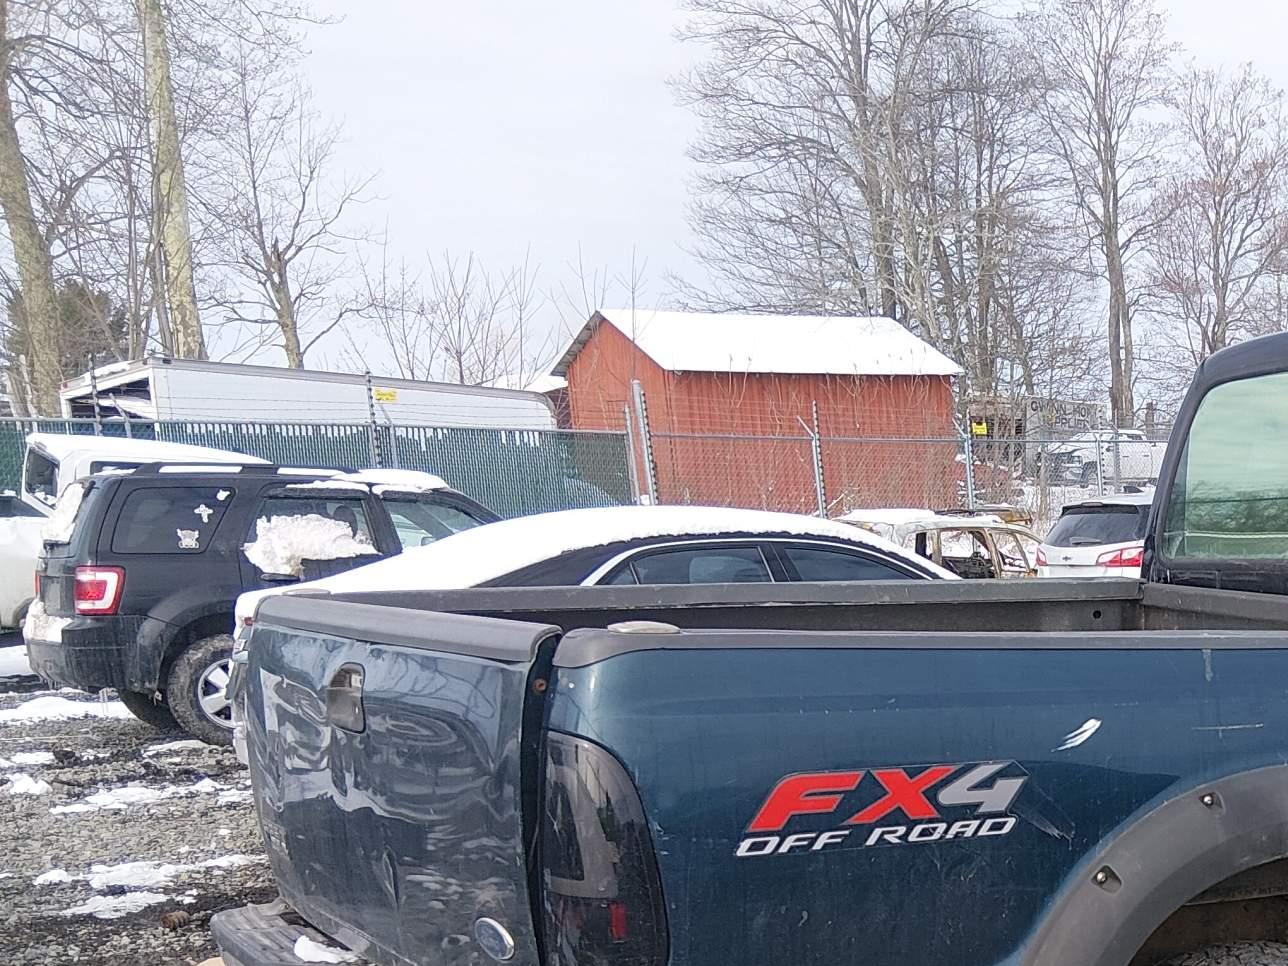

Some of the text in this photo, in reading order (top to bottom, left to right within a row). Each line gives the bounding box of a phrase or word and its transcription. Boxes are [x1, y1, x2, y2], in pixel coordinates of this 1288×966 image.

[748, 762, 1027, 832] FX4
[736, 816, 1017, 857] OFF ROAD
